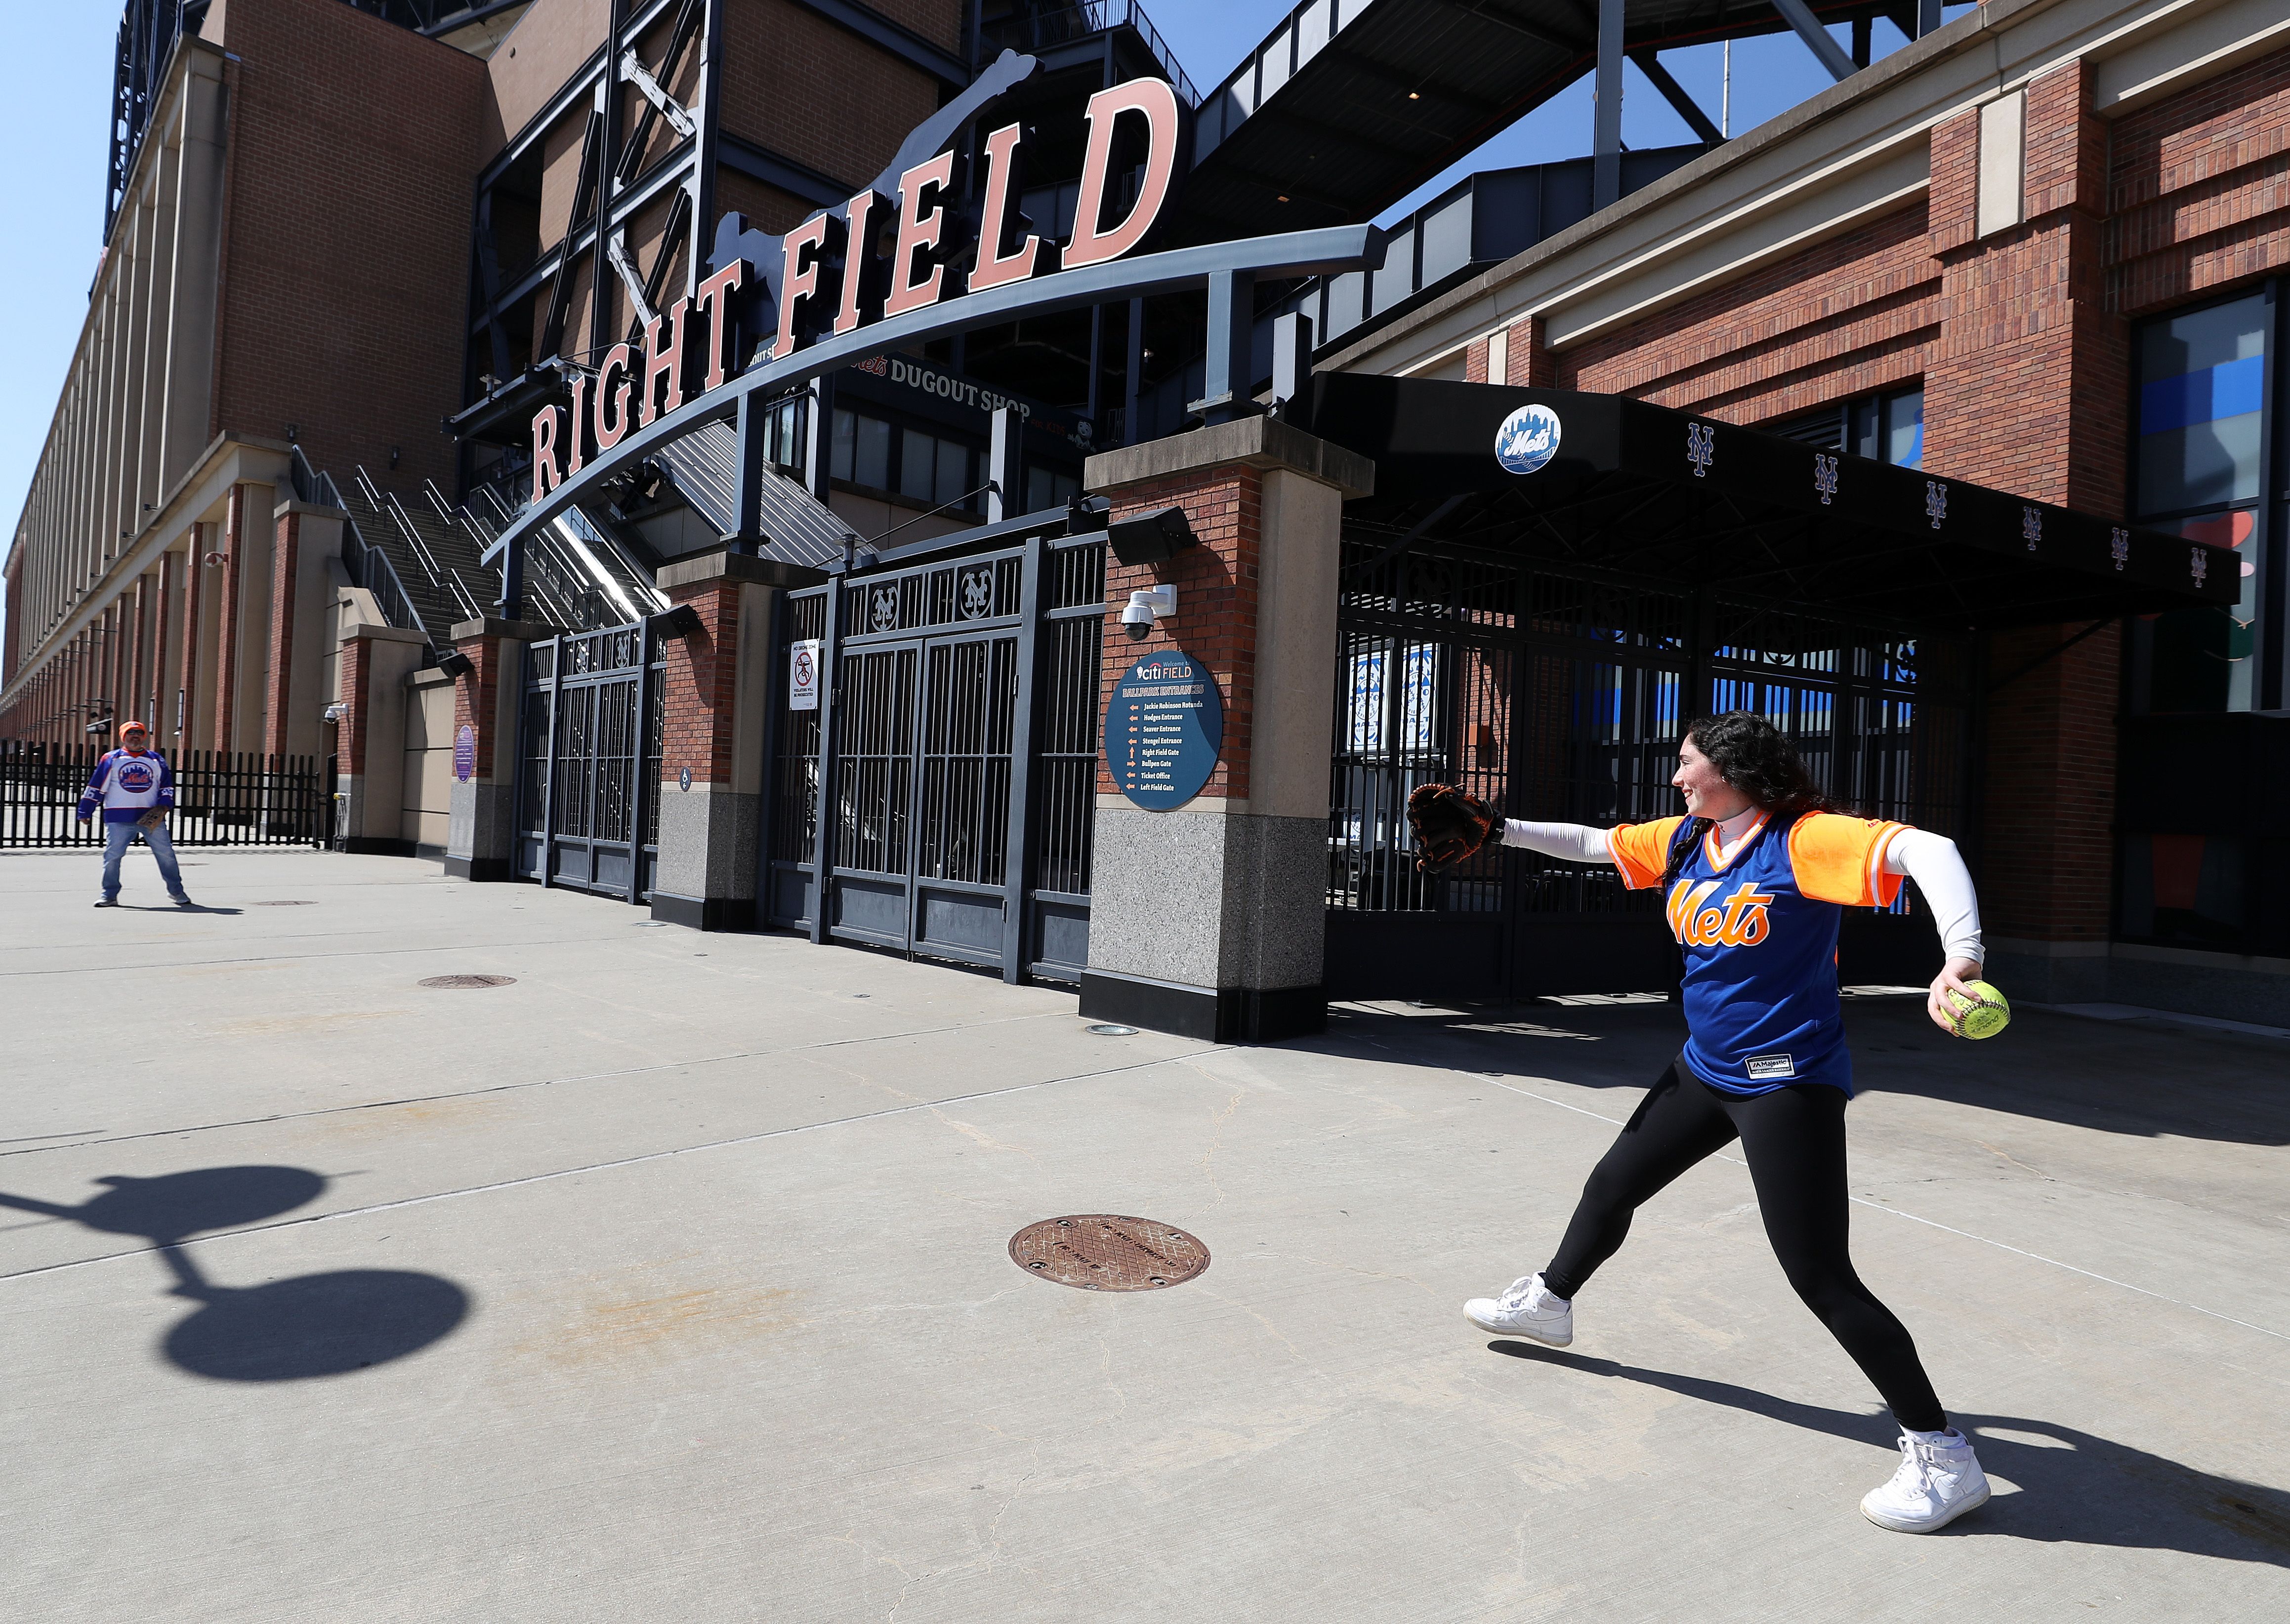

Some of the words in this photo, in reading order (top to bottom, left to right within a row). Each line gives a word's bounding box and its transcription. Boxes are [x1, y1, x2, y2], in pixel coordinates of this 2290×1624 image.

[531, 257, 742, 506] RIGHT
[772, 77, 1179, 360] FIELD
[891, 359, 978, 406] DUGOUT
[1046, 421, 1066, 436] KIDS
[1504, 428, 1551, 457] Mets
[1142, 665, 1161, 680] citi
[1163, 666, 1192, 679] FIELD
[1123, 687, 1159, 697] BALLPARK
[1160, 685, 1204, 696] ENTRANCES
[1144, 702, 1159, 711] Jackie
[1144, 714, 1161, 722] Hodges
[1142, 749, 1155, 757] Right
[1142, 760, 1160, 768] Bullpen
[1666, 878, 1775, 947] Mets
[1761, 1059, 1787, 1068] Majestic
